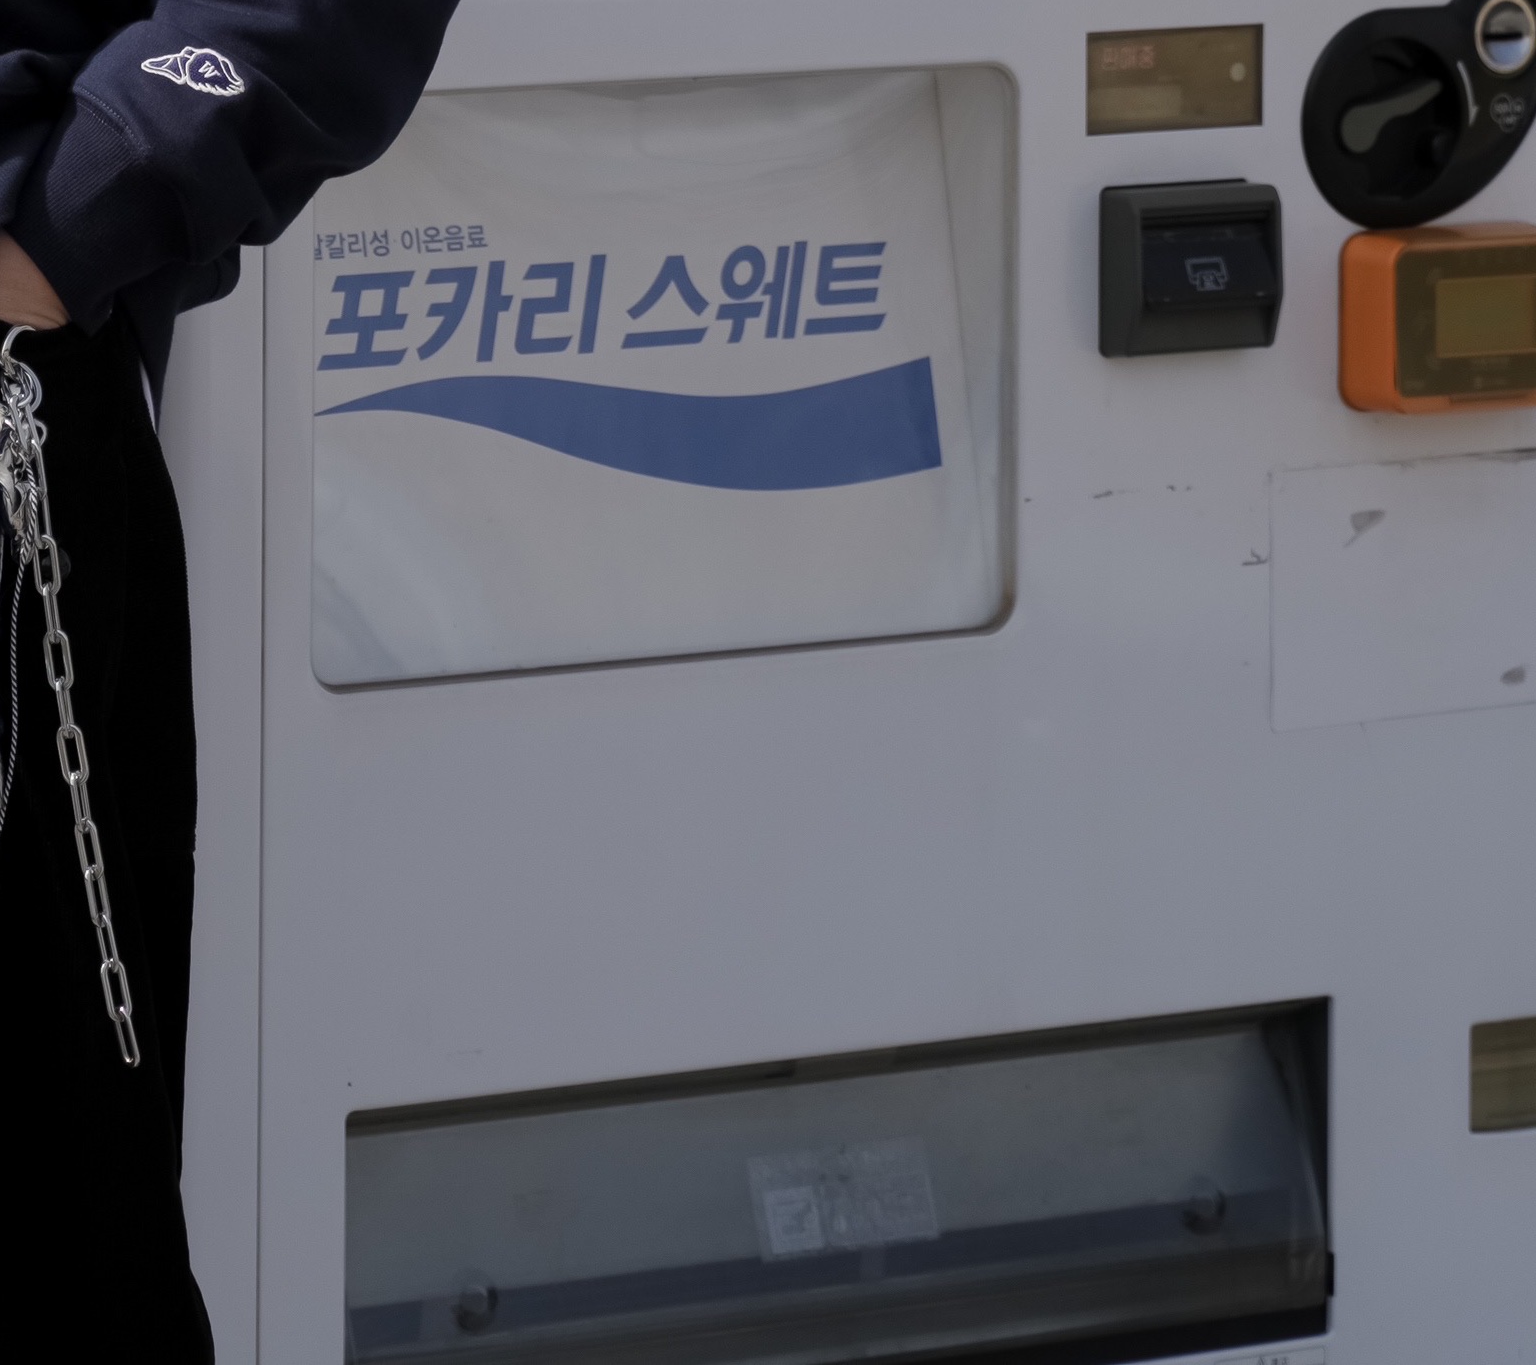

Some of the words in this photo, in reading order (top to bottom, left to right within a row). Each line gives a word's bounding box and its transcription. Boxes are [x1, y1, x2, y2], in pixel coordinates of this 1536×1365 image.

[400, 224, 488, 255] 이온음료
[317, 253, 607, 371] 포카리
[621, 240, 888, 350] 스웨트
